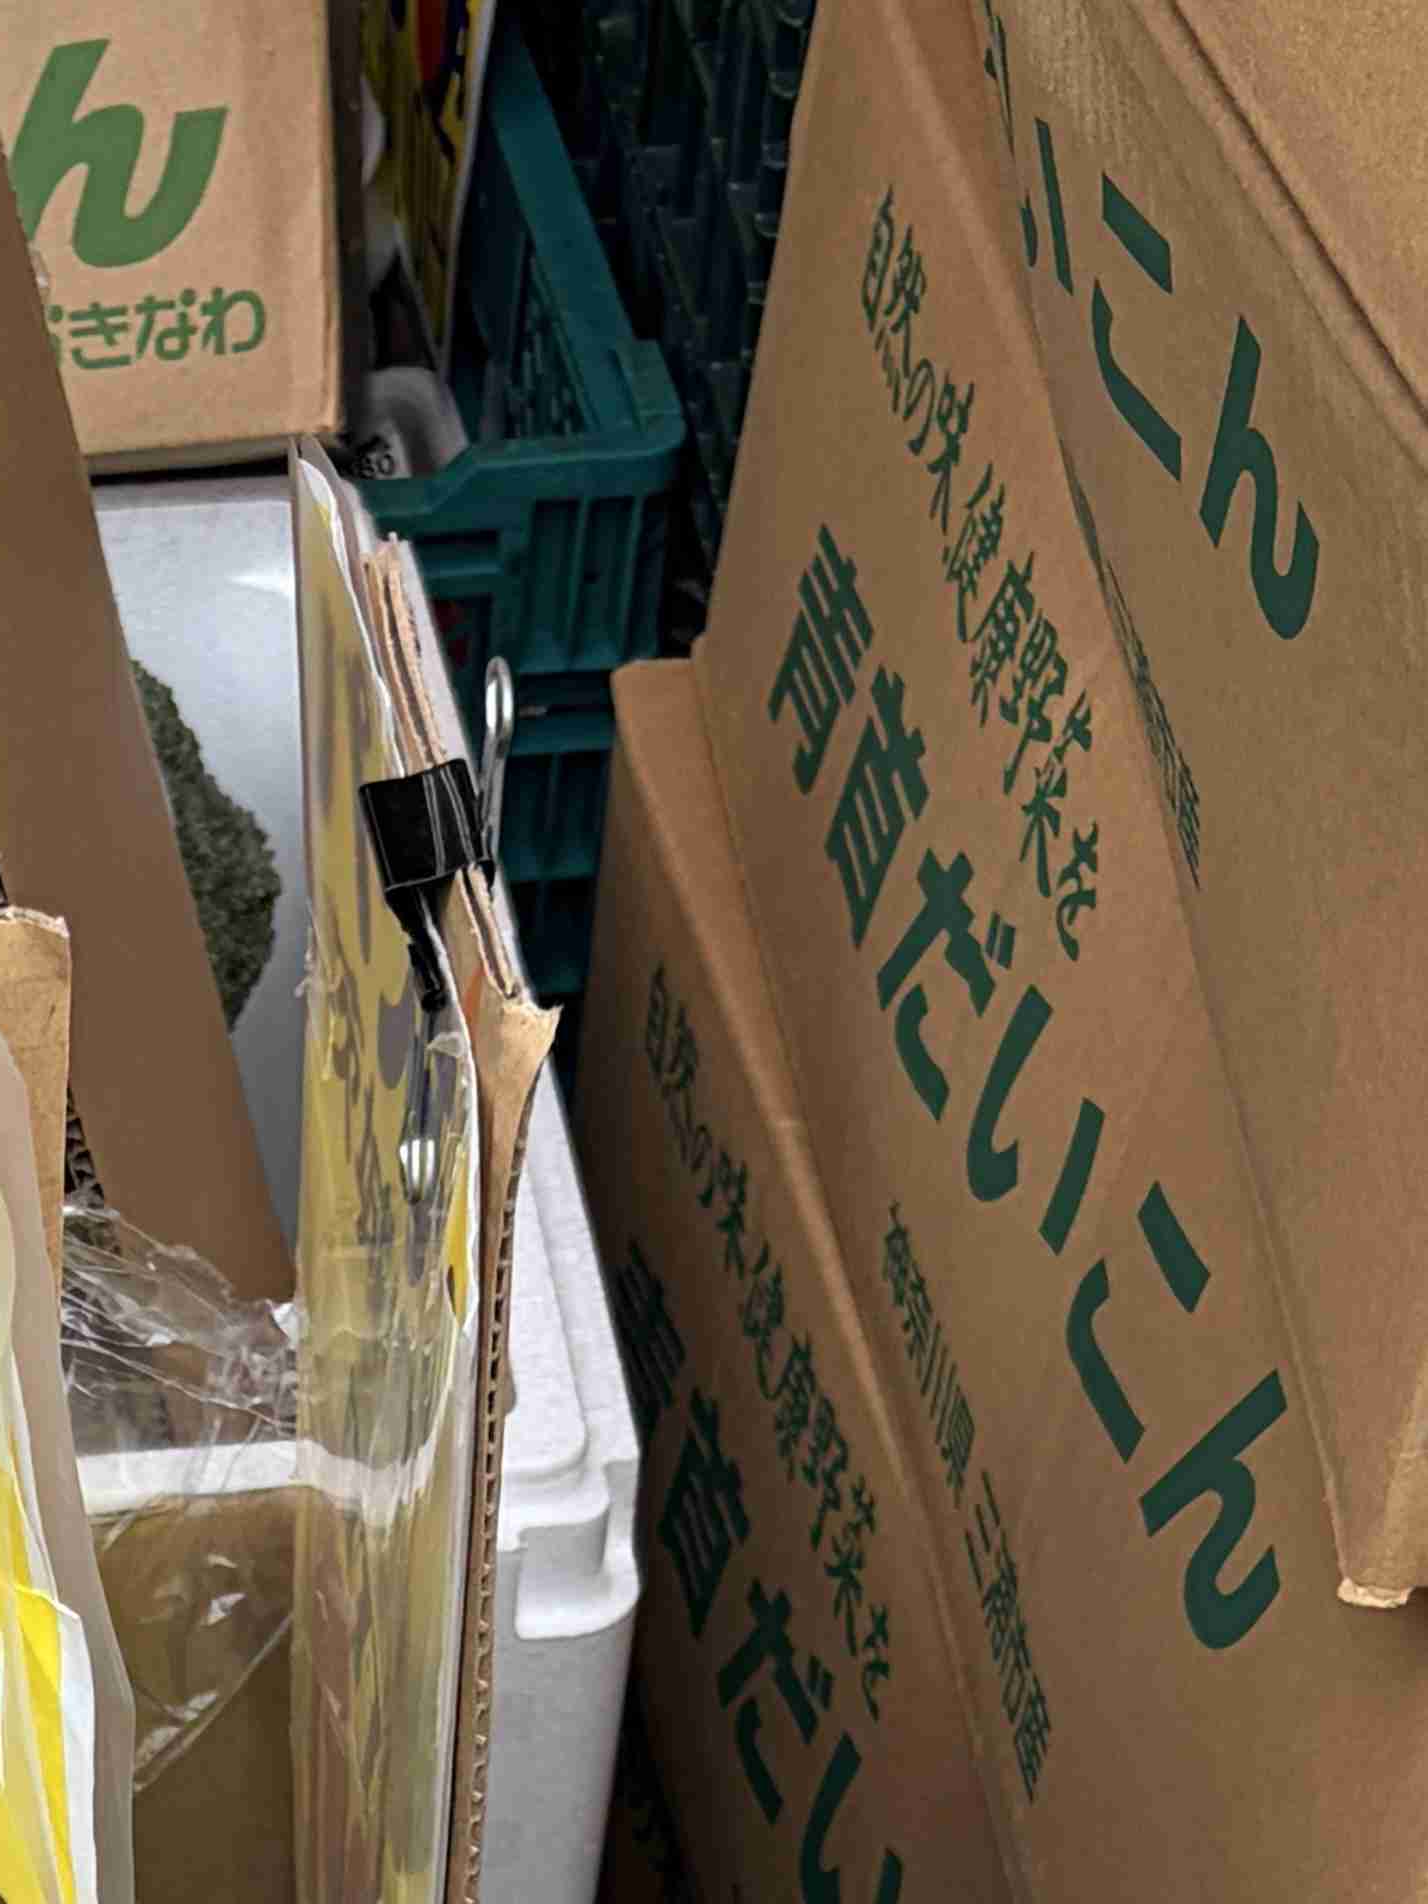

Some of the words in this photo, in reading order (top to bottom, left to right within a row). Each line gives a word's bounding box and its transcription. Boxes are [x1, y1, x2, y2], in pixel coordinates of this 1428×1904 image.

[767, 523, 1288, 1650] 青首だいこん
